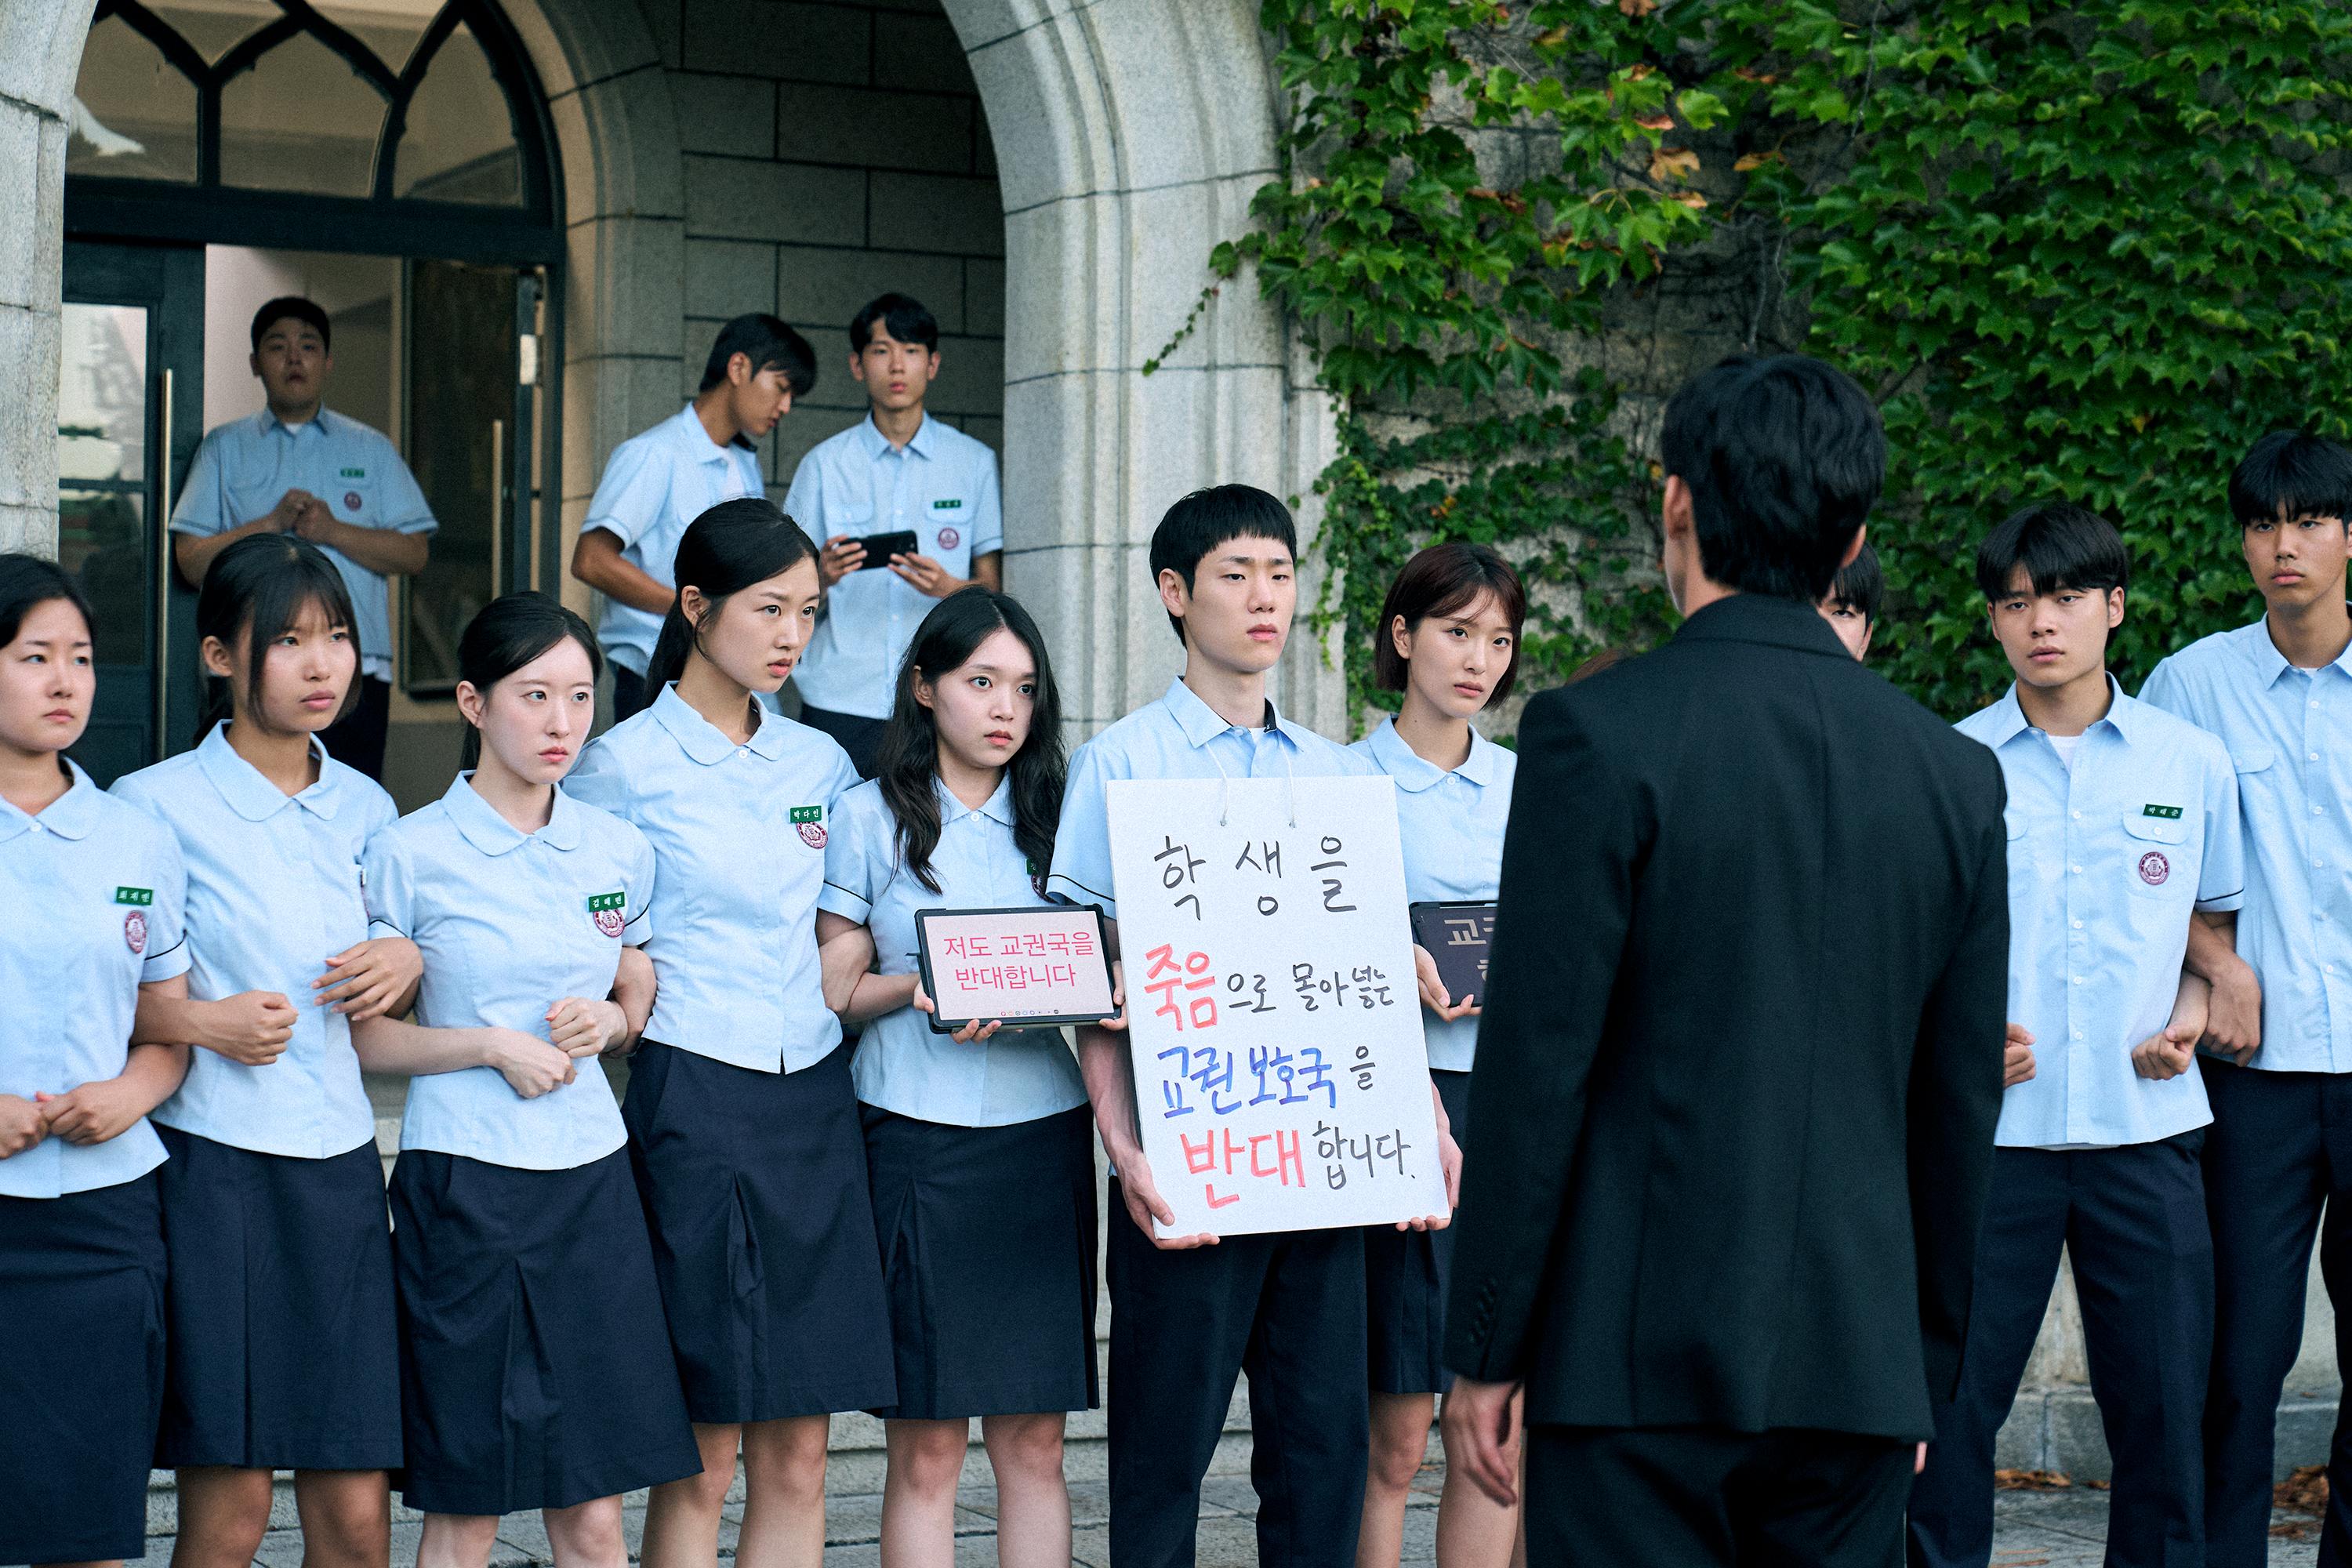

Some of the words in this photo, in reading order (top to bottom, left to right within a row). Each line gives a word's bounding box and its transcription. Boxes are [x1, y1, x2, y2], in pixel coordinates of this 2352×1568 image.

[1153, 835, 1358, 921] 학생을
[943, 935, 993, 960] 저도
[1000, 931, 1094, 956] 교권국을
[1444, 916, 1496, 946] 교
[955, 964, 1076, 991] 반대합니다
[1144, 943, 1277, 1032] 죽음으로
[1292, 963, 1395, 1012] 몰아넣는
